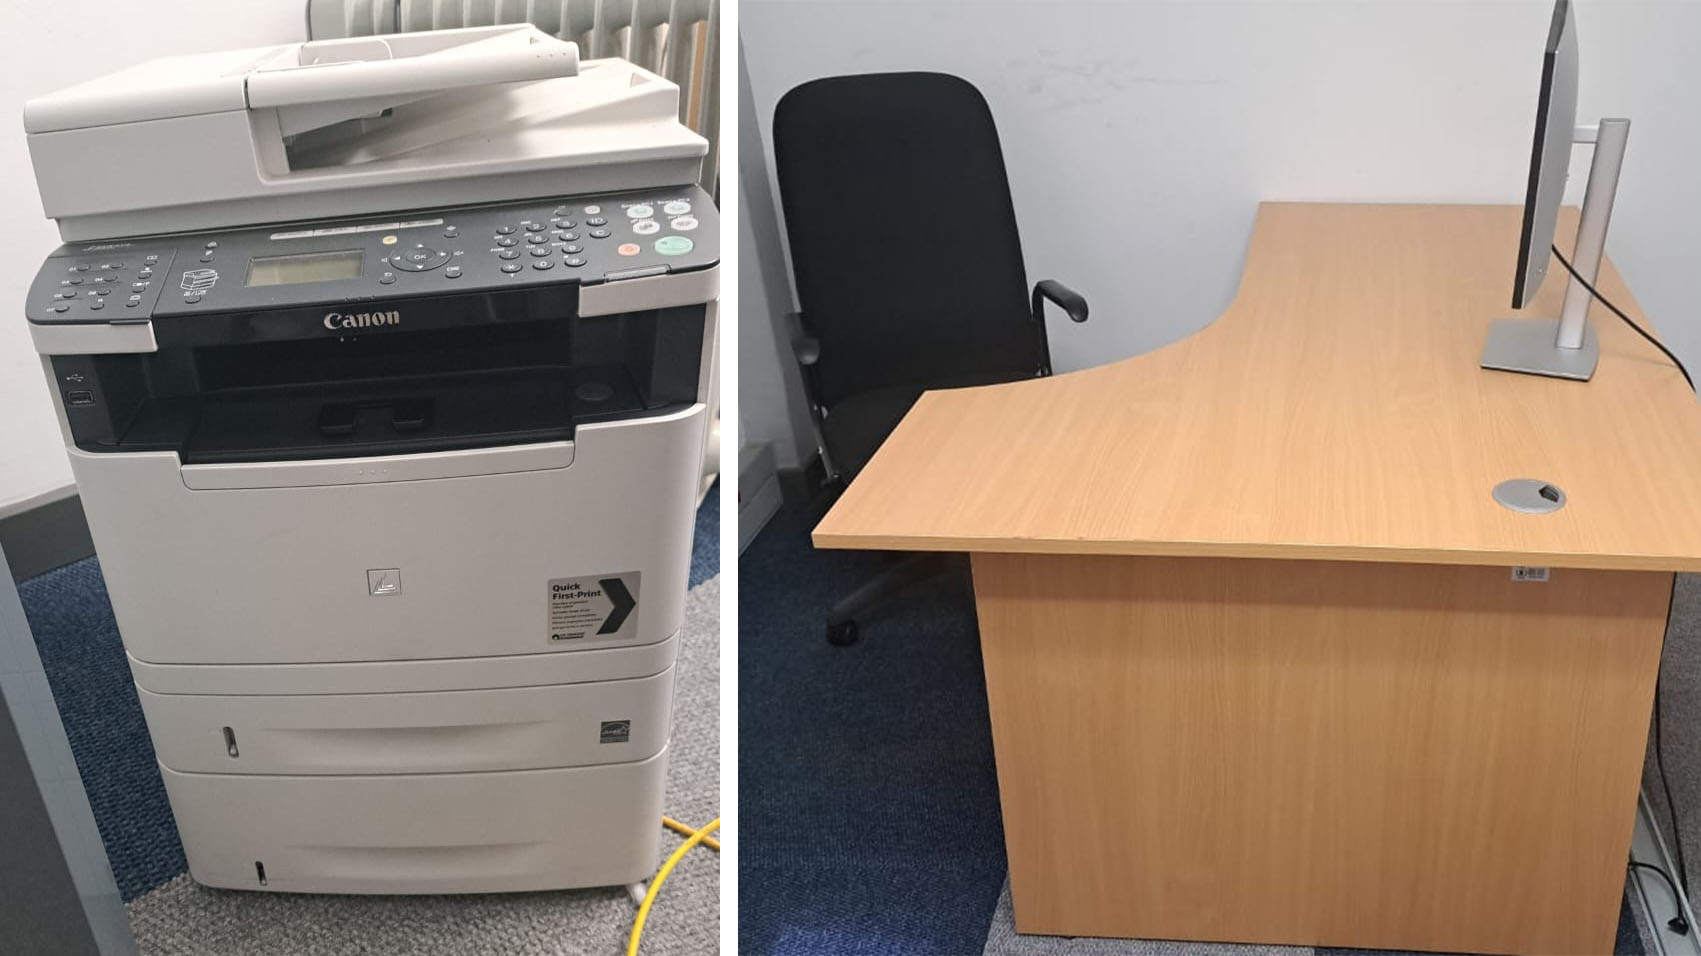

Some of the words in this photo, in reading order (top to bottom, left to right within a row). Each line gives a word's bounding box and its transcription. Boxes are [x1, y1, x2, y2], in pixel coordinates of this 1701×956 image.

[323, 310, 400, 330] Canon
[552, 583, 580, 592] Quick
[552, 591, 601, 600] First-Print
